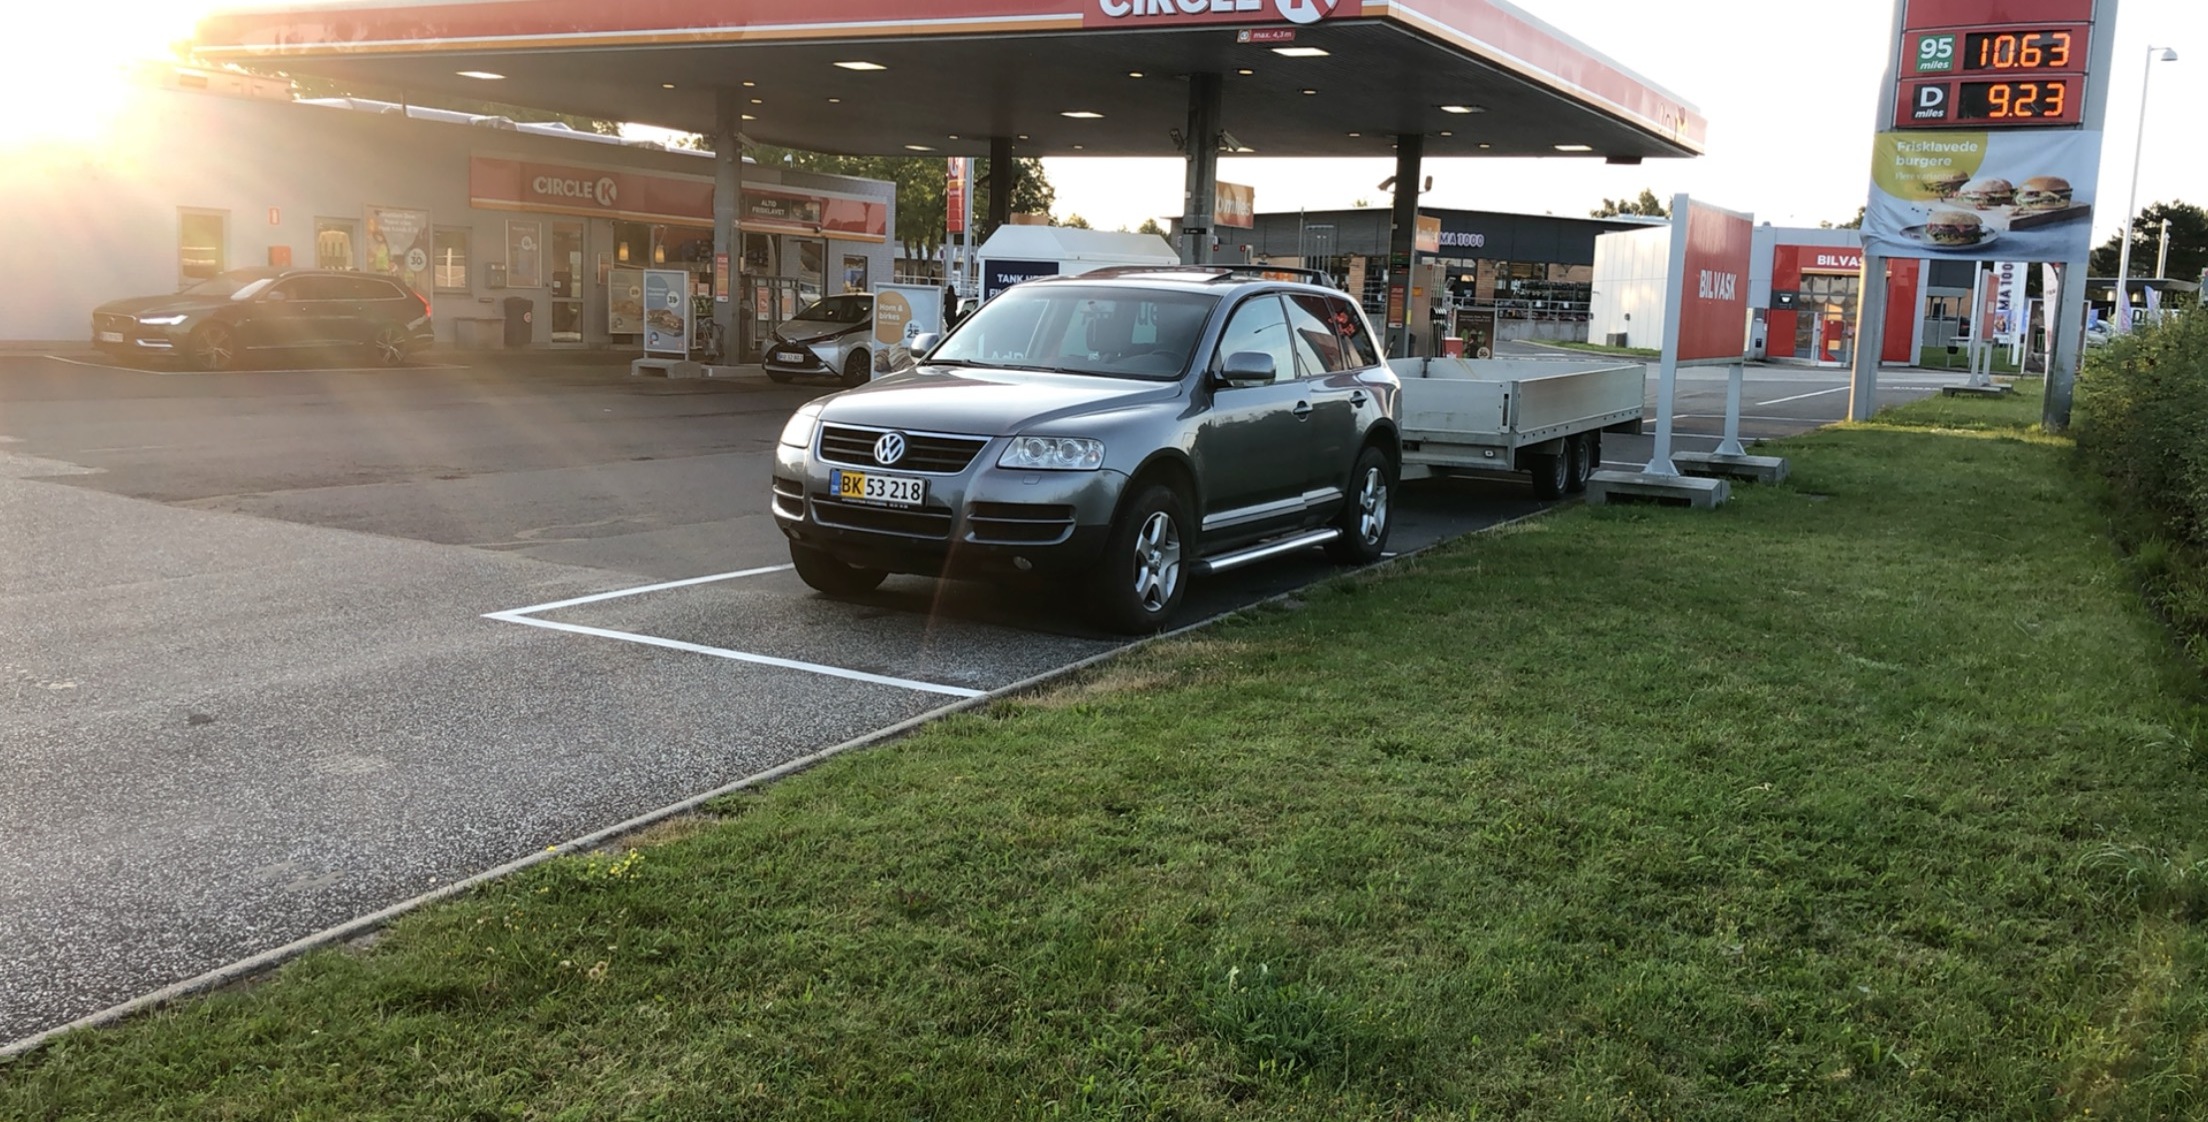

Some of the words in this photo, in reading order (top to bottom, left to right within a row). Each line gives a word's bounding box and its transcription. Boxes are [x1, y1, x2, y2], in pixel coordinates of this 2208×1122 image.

[1920, 38, 1953, 59] 95
[1980, 33, 2071, 68] 10.63
[1919, 60, 1949, 70] miles
[1919, 86, 1944, 107] D
[1988, 83, 2066, 118] 9.23
[1914, 109, 1944, 119] miles
[1896, 141, 1978, 152] Frisklavede
[1895, 155, 1953, 168] burgere
[532, 176, 593, 198] CIRCLE
[595, 177, 618, 206] K
[1457, 232, 1485, 248] 1000
[997, 273, 1024, 284] TANK
[1698, 269, 1737, 302] BILVASK
[842, 475, 862, 495] BK
[866, 478, 886, 497] 53
[889, 480, 921, 501] 218
